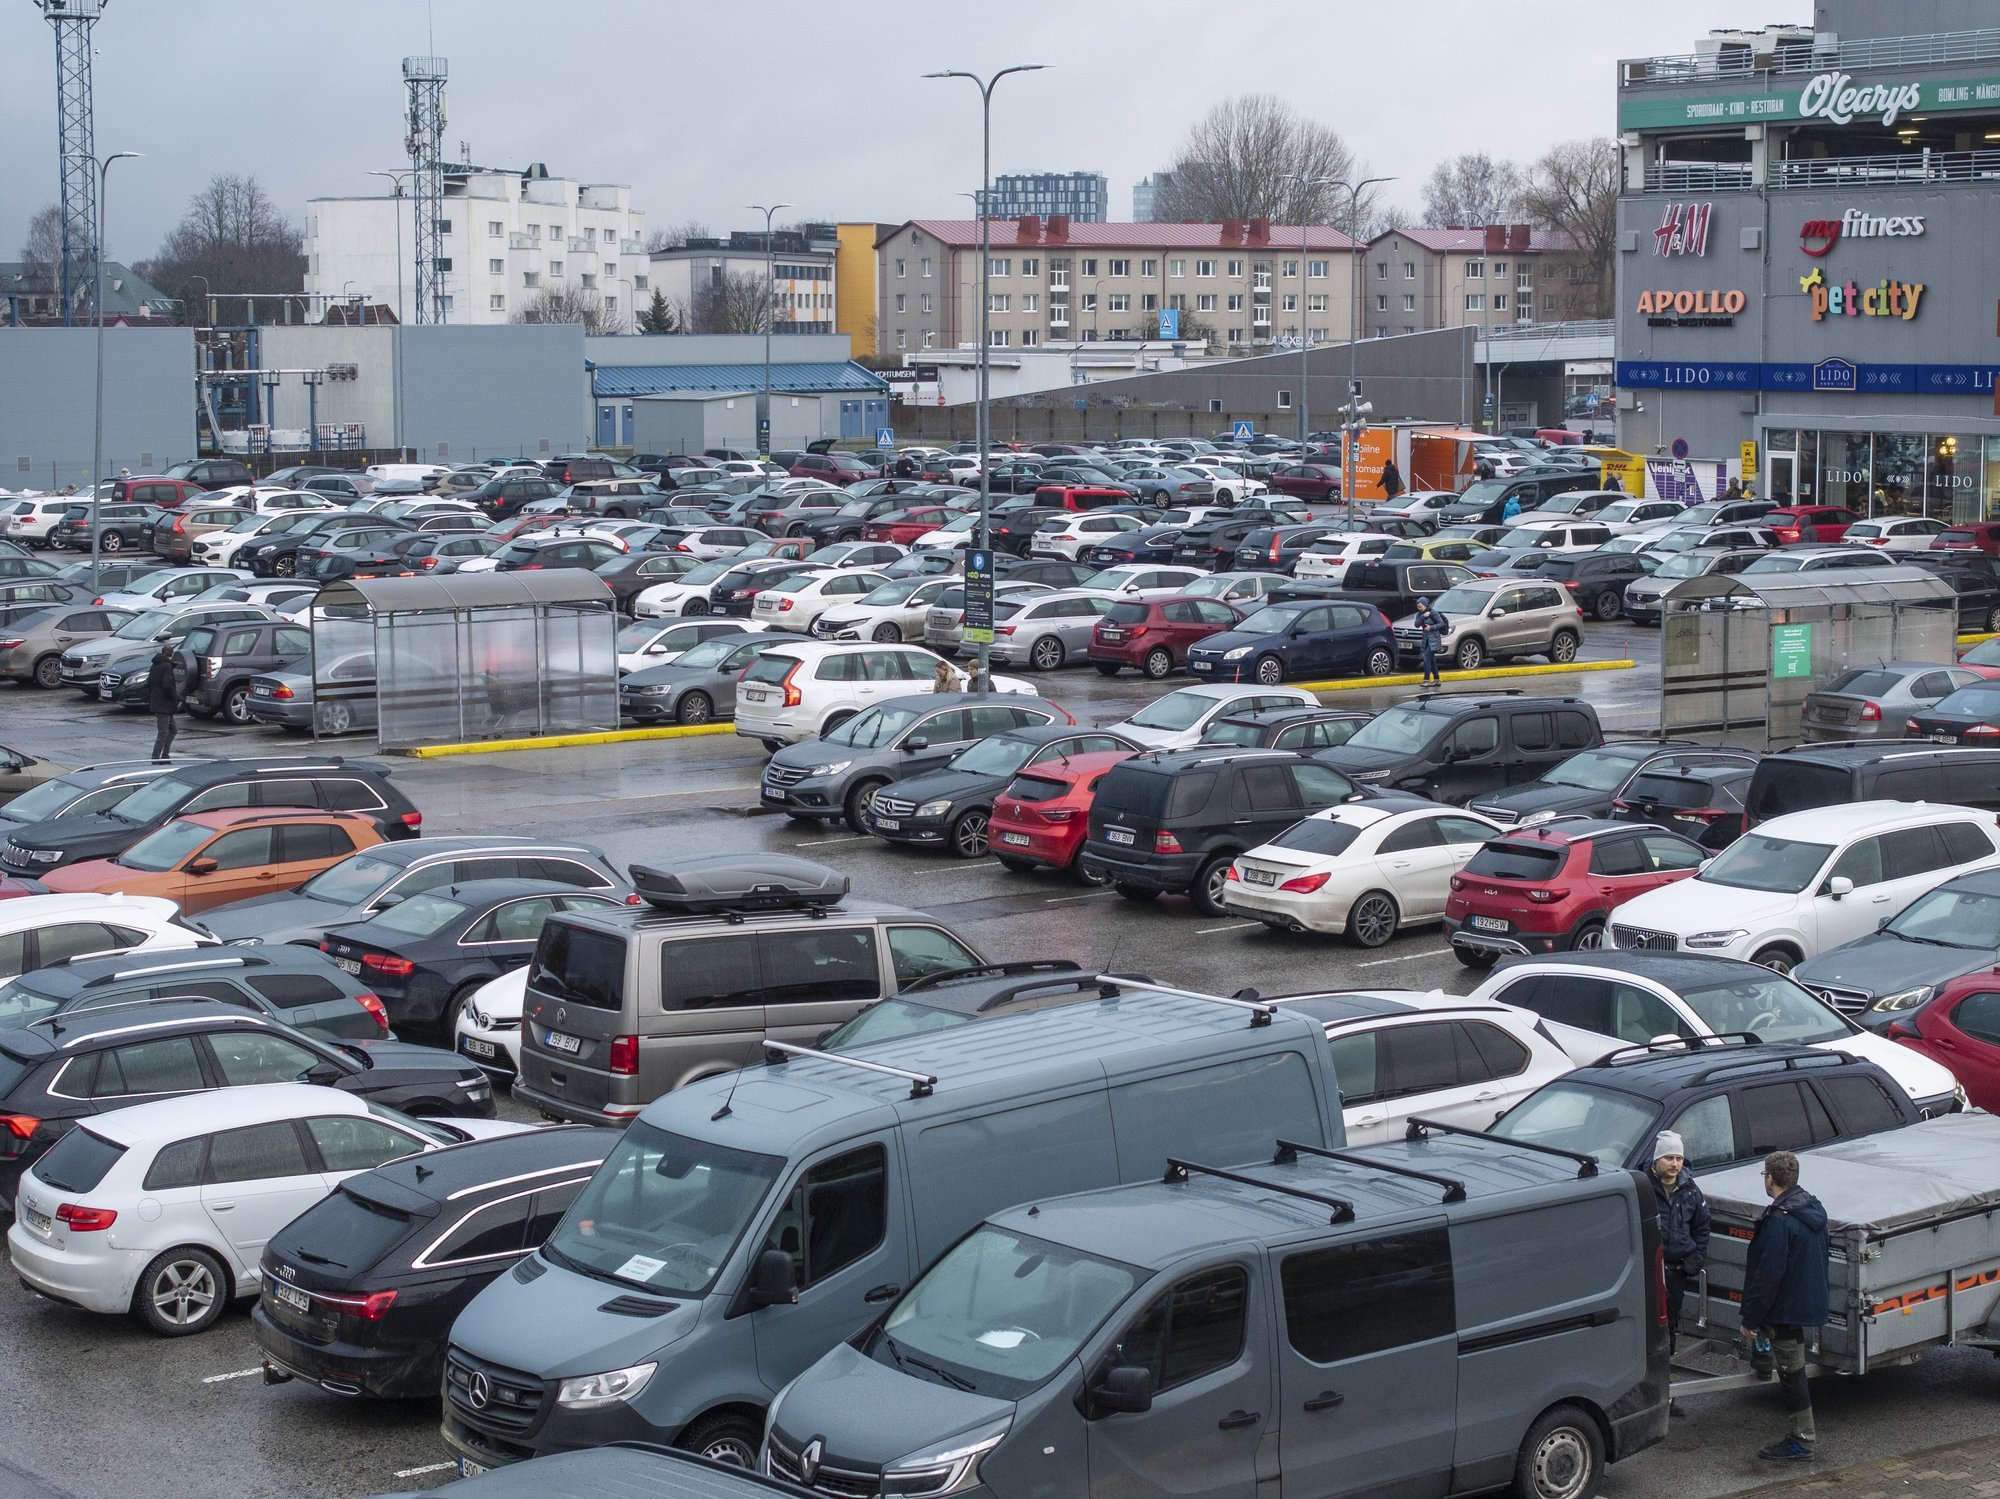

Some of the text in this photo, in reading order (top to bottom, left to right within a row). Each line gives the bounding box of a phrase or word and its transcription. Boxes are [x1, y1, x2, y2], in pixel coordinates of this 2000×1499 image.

[1938, 86, 1969, 103] BOWLING
[1686, 99, 1784, 118] SPORDIBAAR KINO RESTORAN
[1652, 202, 1712, 258] H&M
[1636, 289, 1746, 314] APOLLO
[1810, 278, 1924, 321] pet city
[1664, 367, 1710, 384] LIDO
[1820, 369, 1850, 381] LIDO
[1346, 464, 1384, 474] atomaat
[1606, 463, 1628, 472] DHL
[1827, 470, 1862, 483] LIDO
[1935, 475, 1972, 488] LIDO
